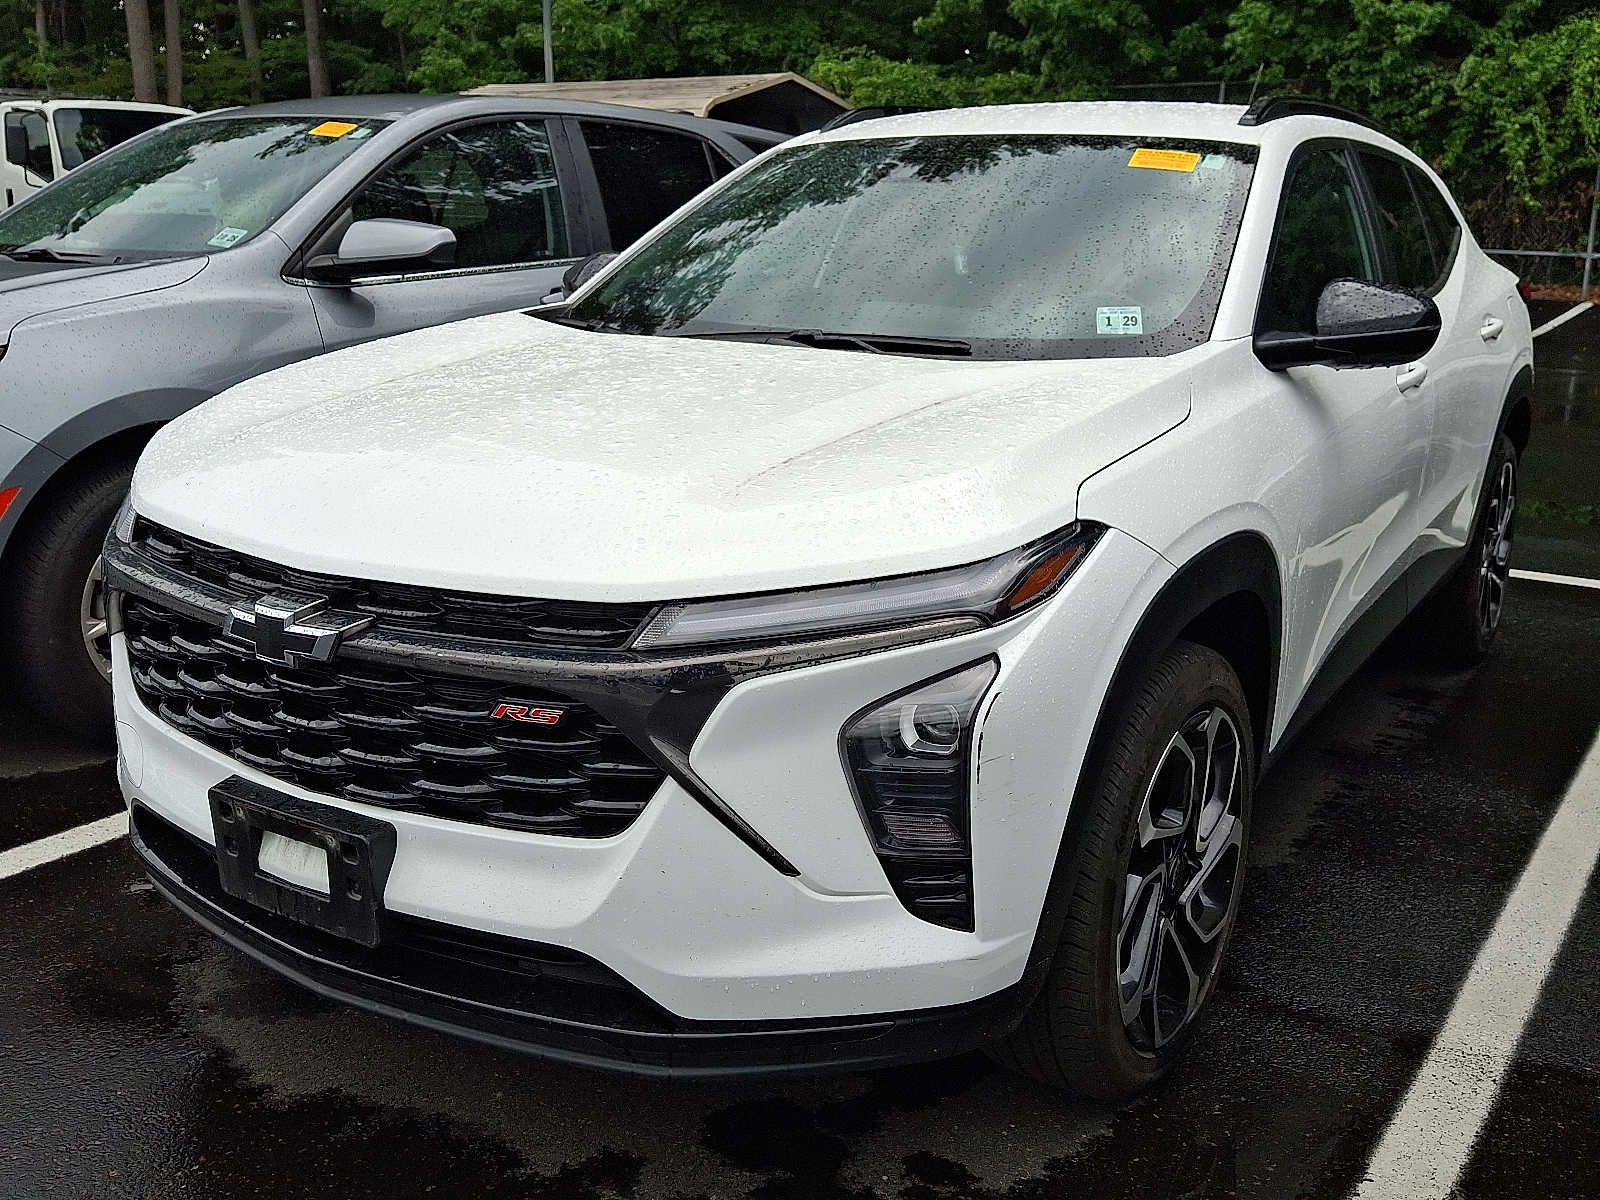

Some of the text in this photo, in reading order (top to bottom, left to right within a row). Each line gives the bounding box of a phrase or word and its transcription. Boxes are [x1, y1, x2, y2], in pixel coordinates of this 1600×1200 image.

[1105, 315, 1138, 327] 1 29
[490, 703, 564, 725] RS
